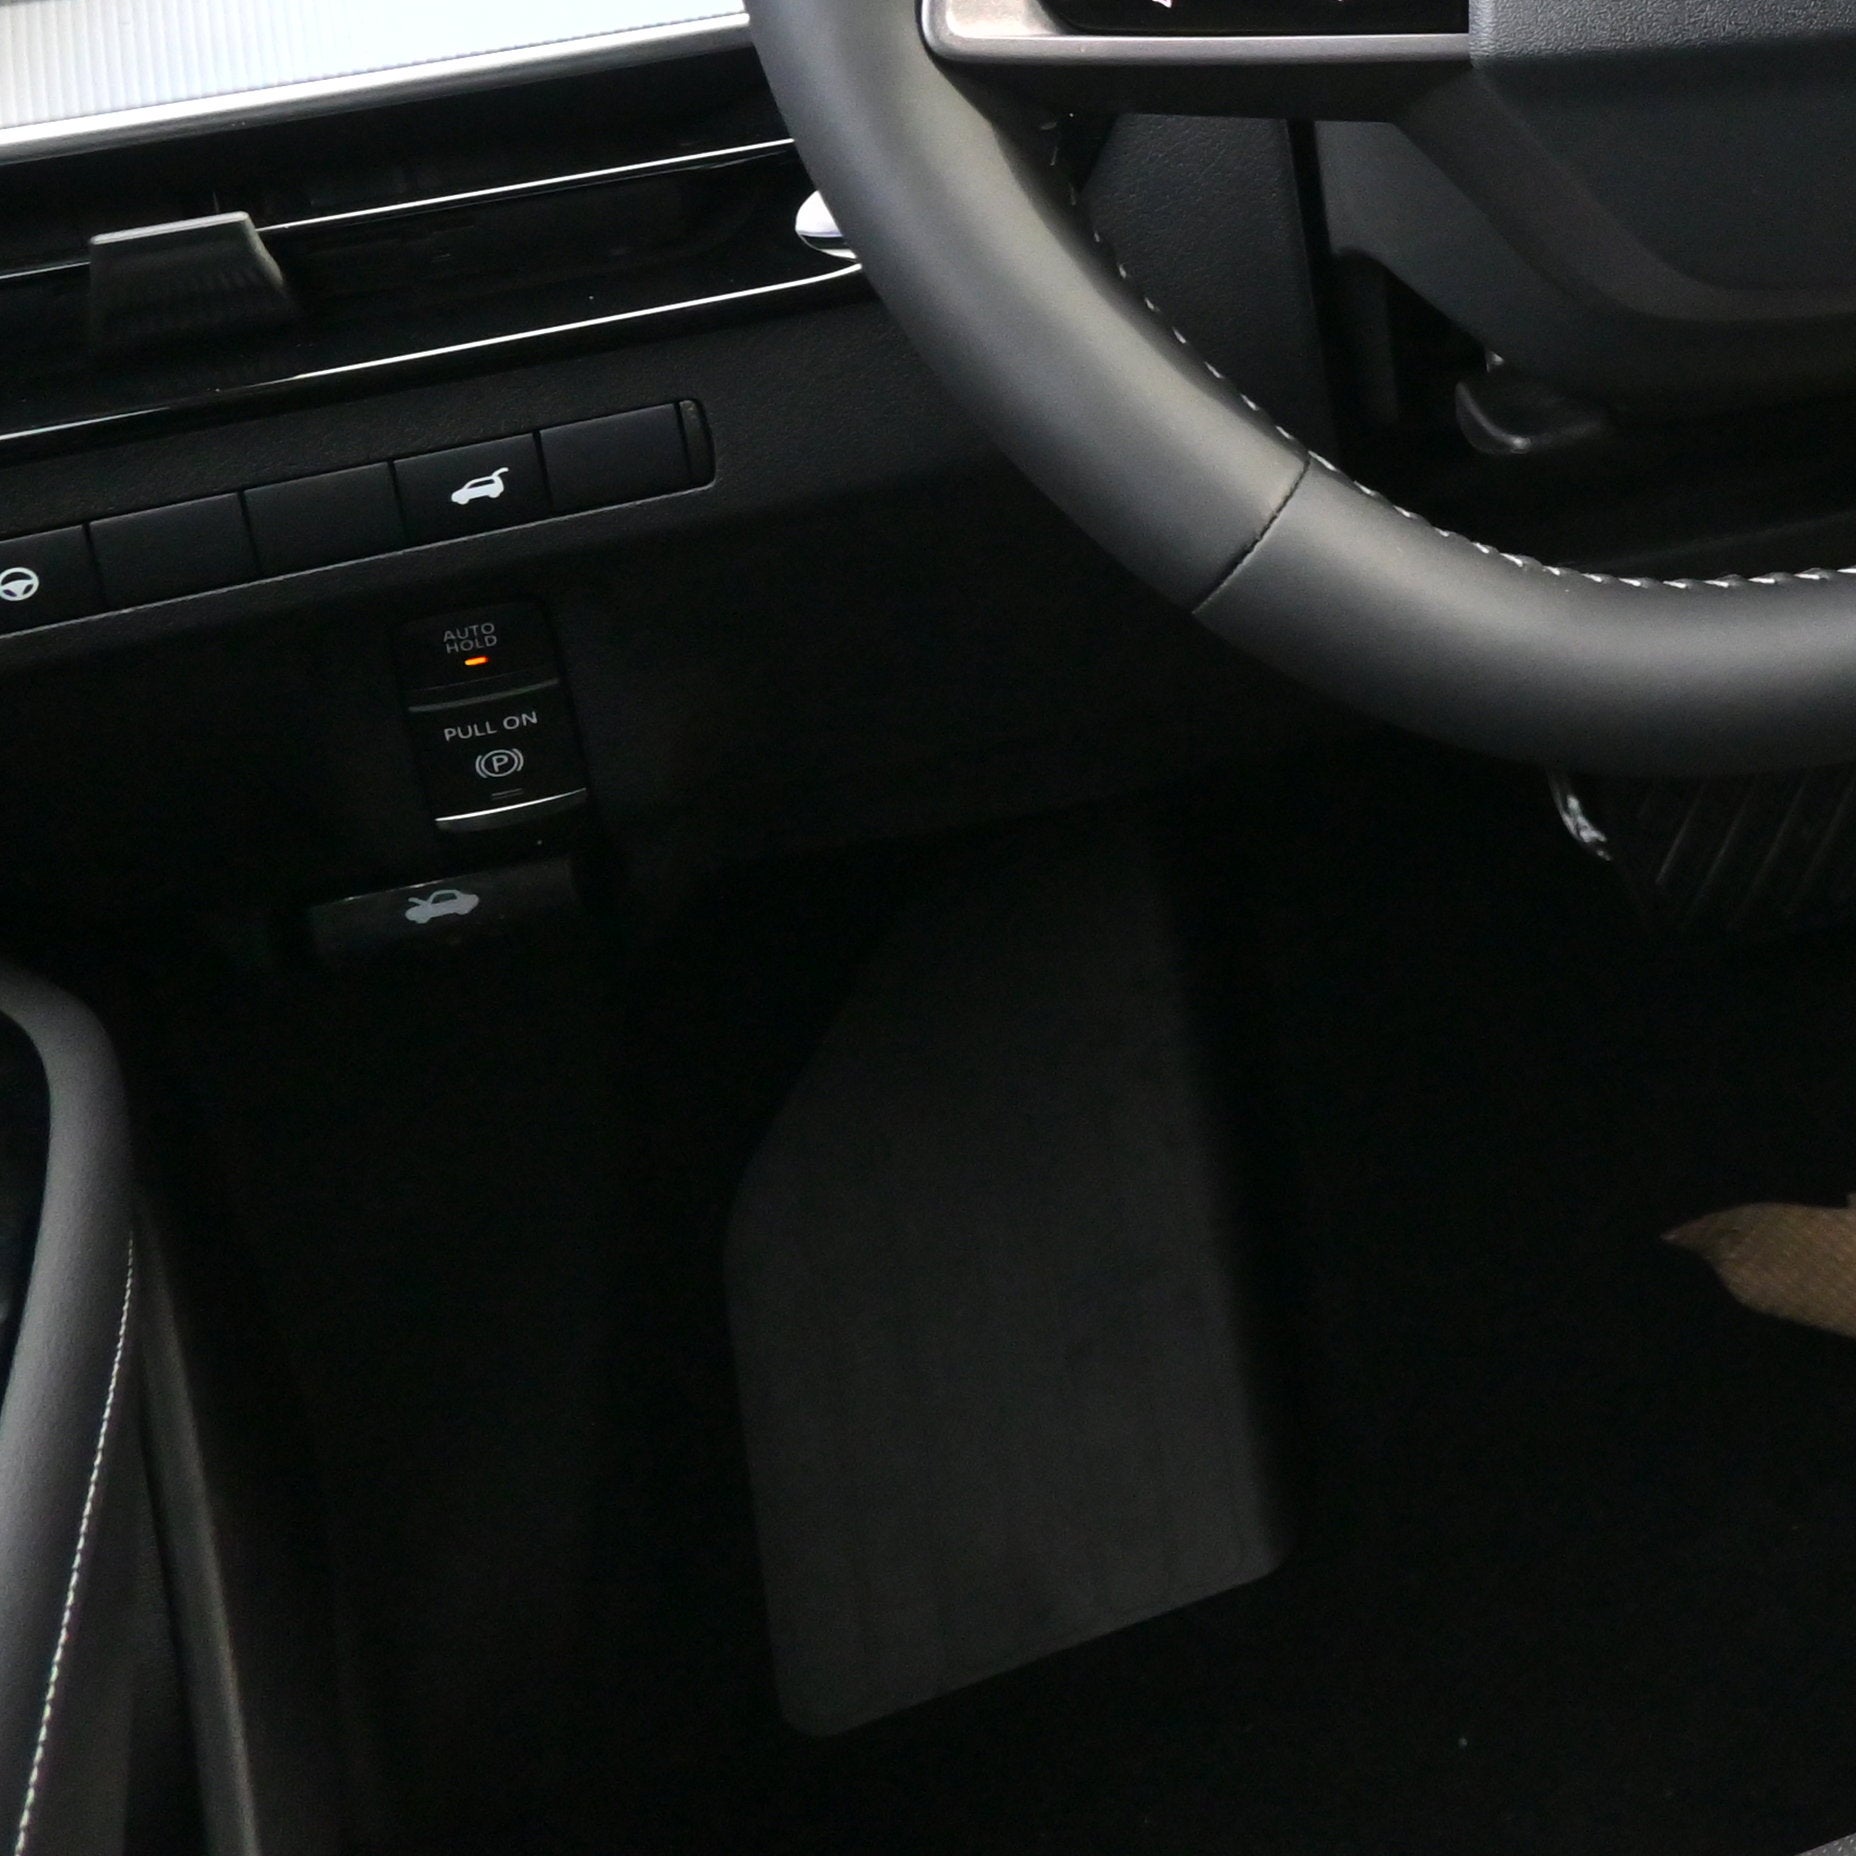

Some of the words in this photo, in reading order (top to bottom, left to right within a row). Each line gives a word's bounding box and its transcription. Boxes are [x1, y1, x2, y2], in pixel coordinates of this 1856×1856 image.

[443, 622, 495, 642] AUTO
[446, 634, 498, 654] HOLD
[443, 720, 498, 742] PULL
[502, 710, 539, 730] ON
